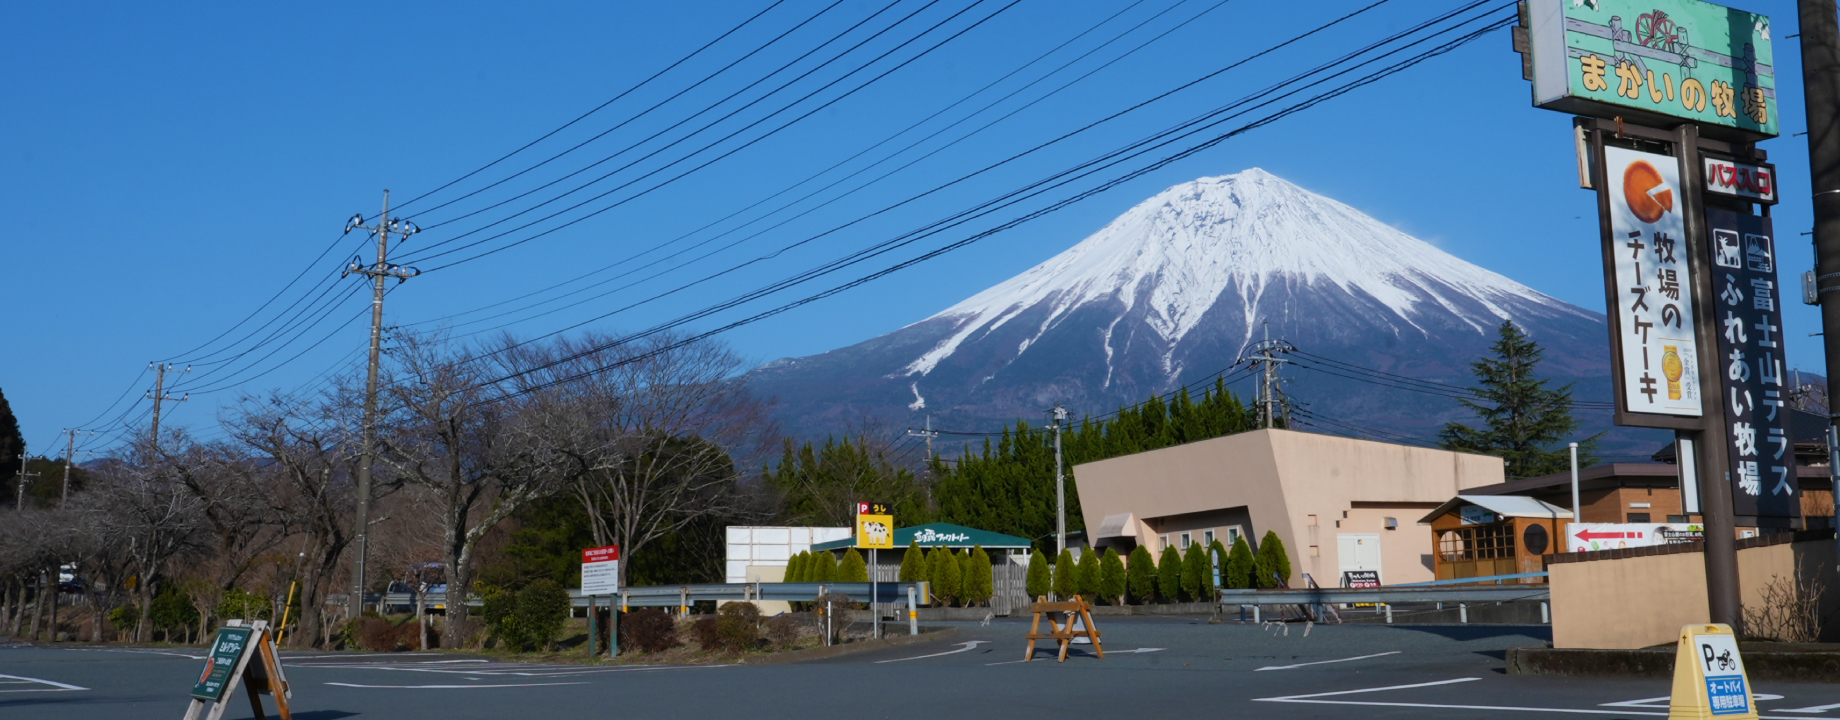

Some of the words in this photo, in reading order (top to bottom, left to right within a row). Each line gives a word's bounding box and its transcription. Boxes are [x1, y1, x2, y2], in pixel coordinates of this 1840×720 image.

[1580, 54, 1766, 124] まかいの牧場
[1708, 163, 1771, 195] バス入口
[1653, 231, 1682, 329] 牧場の
[1627, 230, 1658, 404] チーズケーキ
[1720, 273, 1763, 496] ふれあい牧場
[1750, 278, 1793, 497] 富士山テラス
[861, 504, 868, 513] P
[872, 504, 887, 513] うし
[1702, 643, 1715, 672] P
[1709, 680, 1742, 694] オートバイ
[1711, 694, 1746, 709] 専用駐車場
